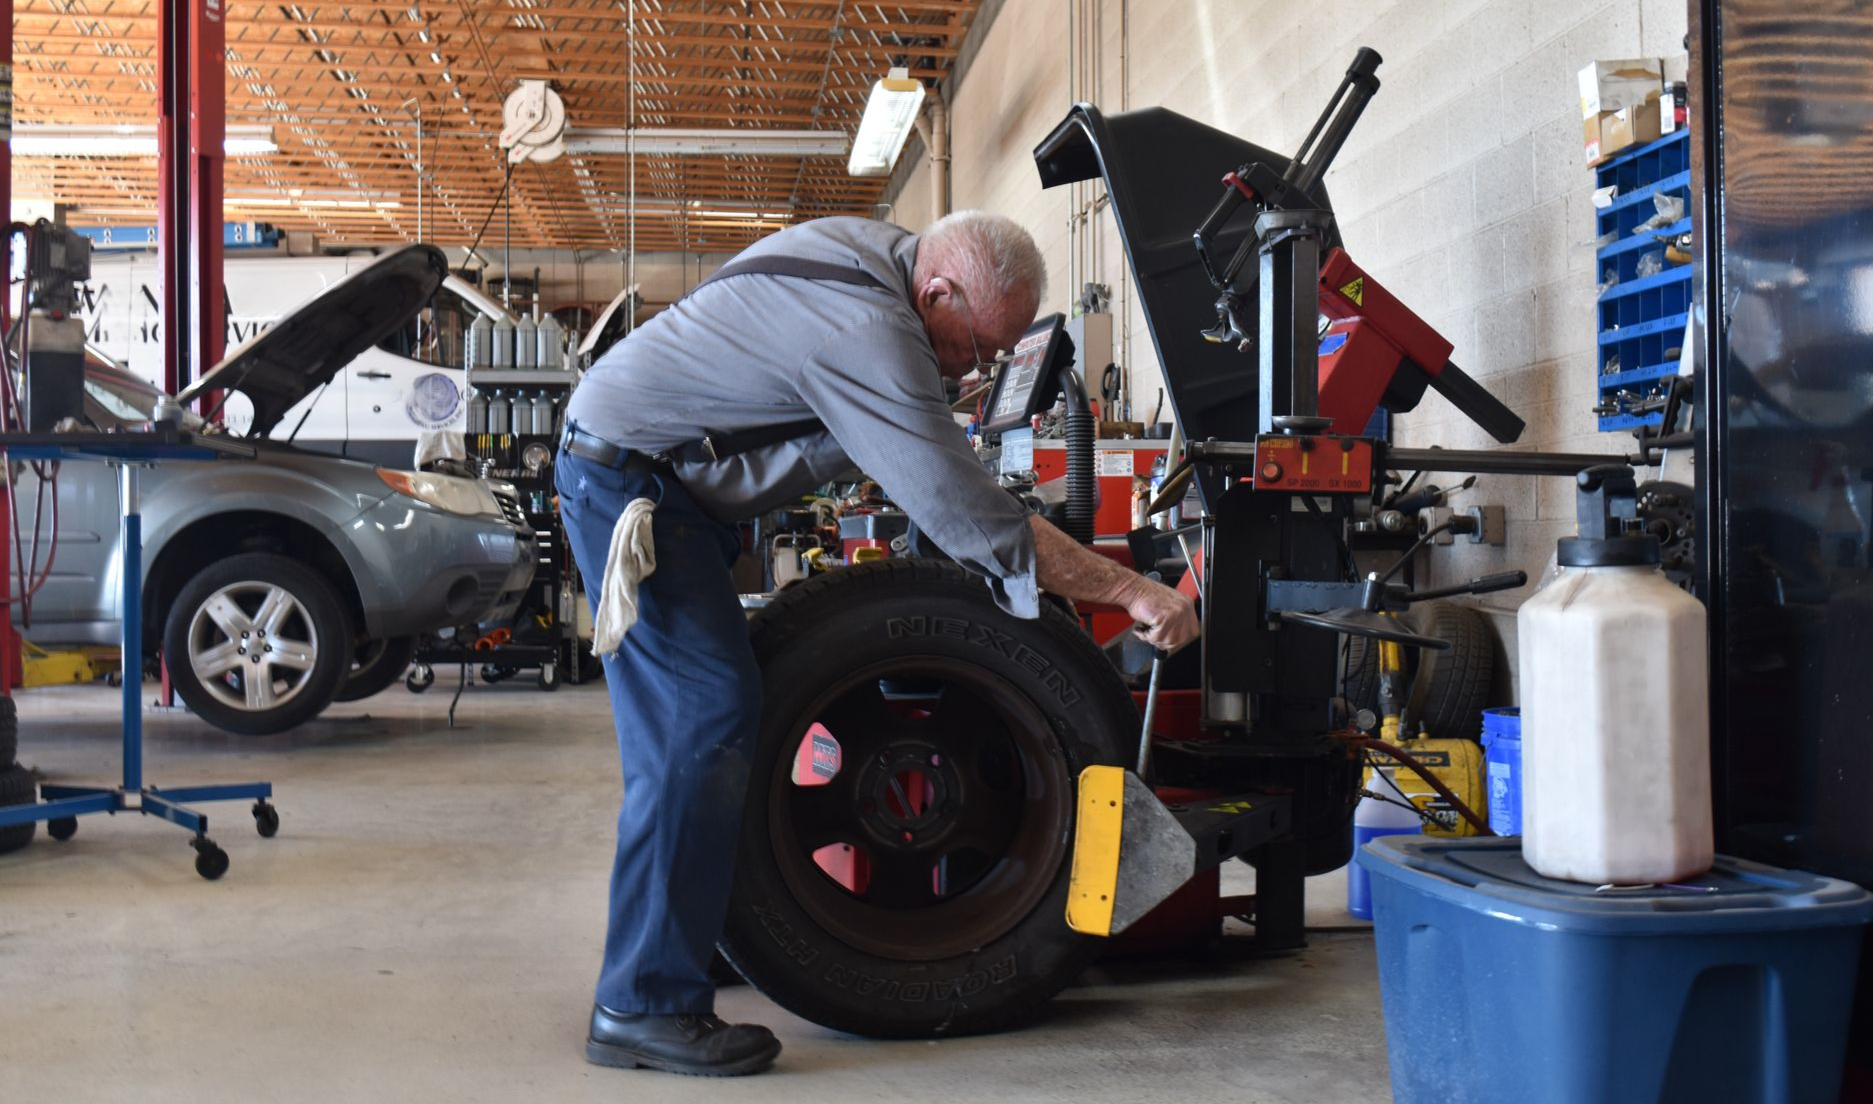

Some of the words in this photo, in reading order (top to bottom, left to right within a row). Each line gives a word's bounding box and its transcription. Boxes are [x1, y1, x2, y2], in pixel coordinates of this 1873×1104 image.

[1300, 479, 1320, 488] 2000
[1343, 480, 1362, 489] 1000
[886, 616, 1081, 709] NEXEN
[751, 900, 819, 967] HTX
[824, 953, 1018, 1002] ROADIAN
